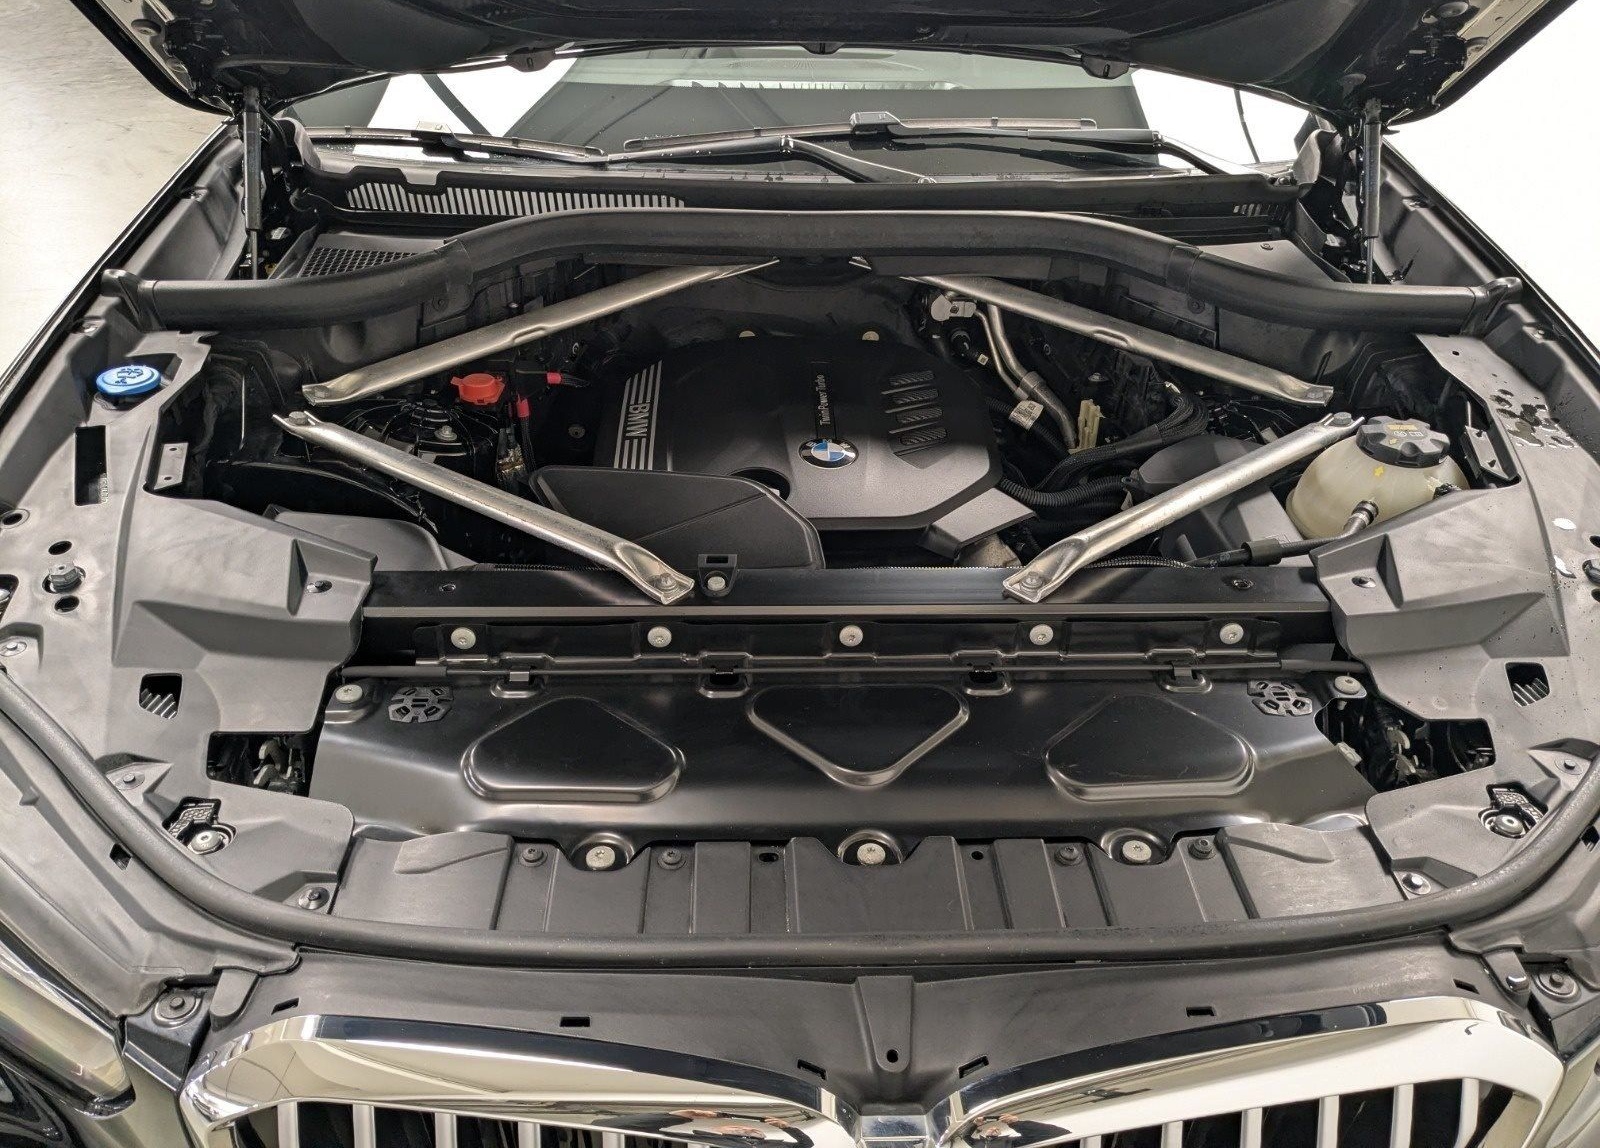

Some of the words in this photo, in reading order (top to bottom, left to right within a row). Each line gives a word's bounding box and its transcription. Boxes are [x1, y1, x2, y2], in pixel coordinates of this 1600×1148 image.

[815, 374, 827, 392] Turbo
[625, 402, 651, 437] BMW
[817, 391, 831, 426] TwinPower
